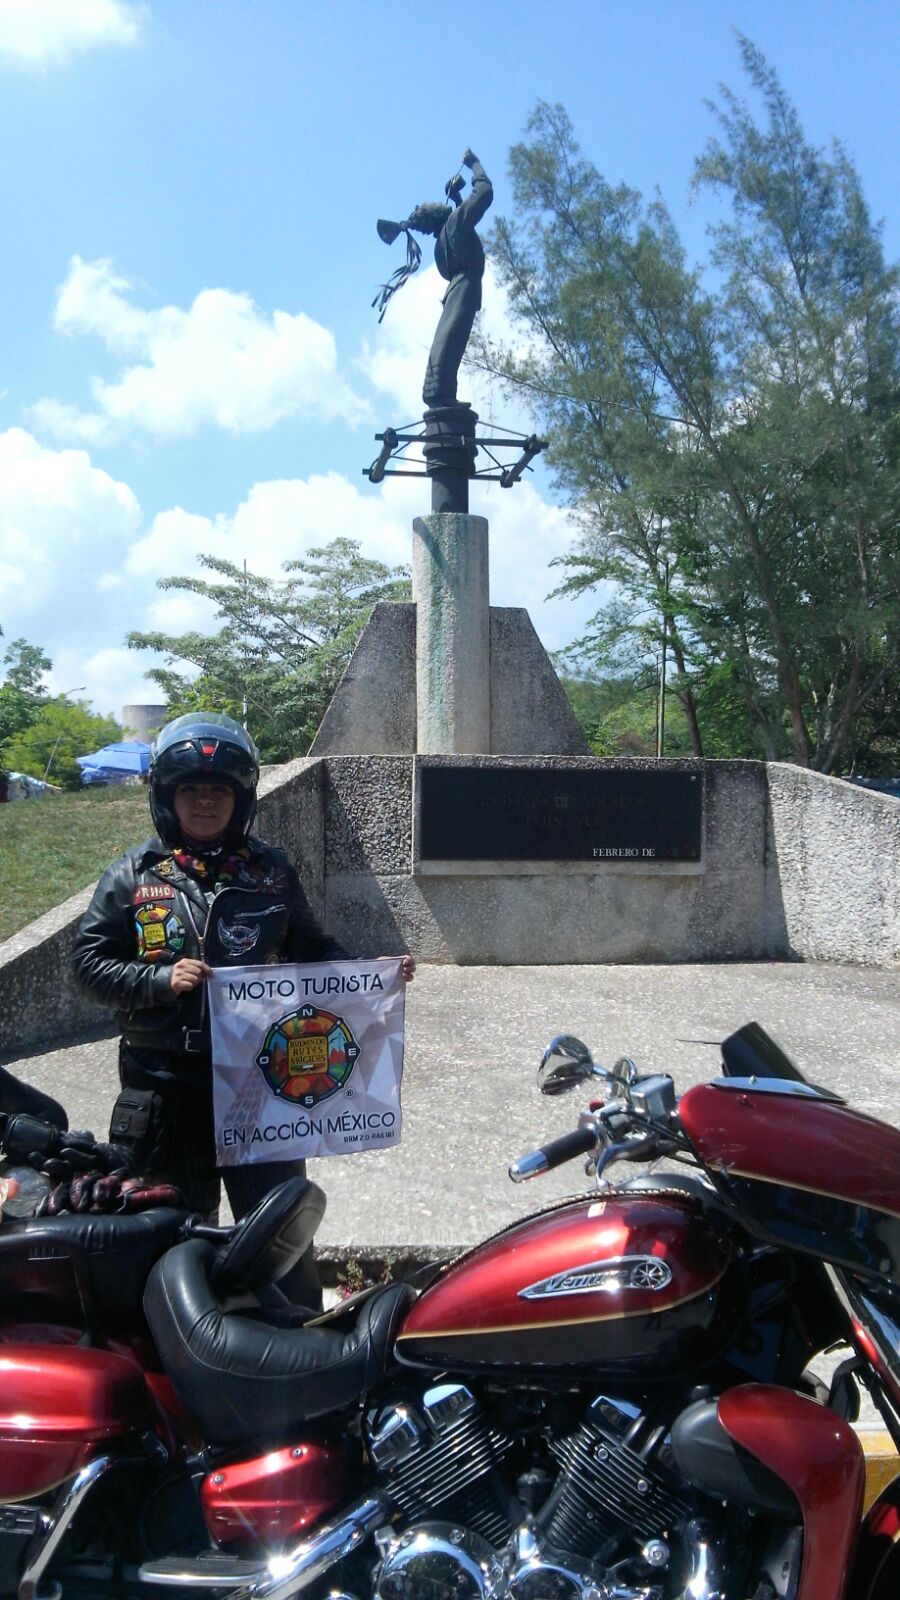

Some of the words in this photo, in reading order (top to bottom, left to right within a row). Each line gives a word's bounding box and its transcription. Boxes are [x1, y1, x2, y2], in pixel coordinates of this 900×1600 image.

[592, 847, 639, 857] FEBRERO
[642, 847, 656, 857] DE
[228, 979, 295, 1001] MOTO
[301, 973, 384, 996] TURISTA
[302, 1008, 313, 1017] N
[348, 1048, 357, 1056] E
[259, 1056, 269, 1065] O
[304, 1095, 314, 1104] S
[223, 1128, 246, 1147] EN
[251, 1115, 323, 1144] ACCIÓN
[327, 1111, 396, 1134] MÉXICO
